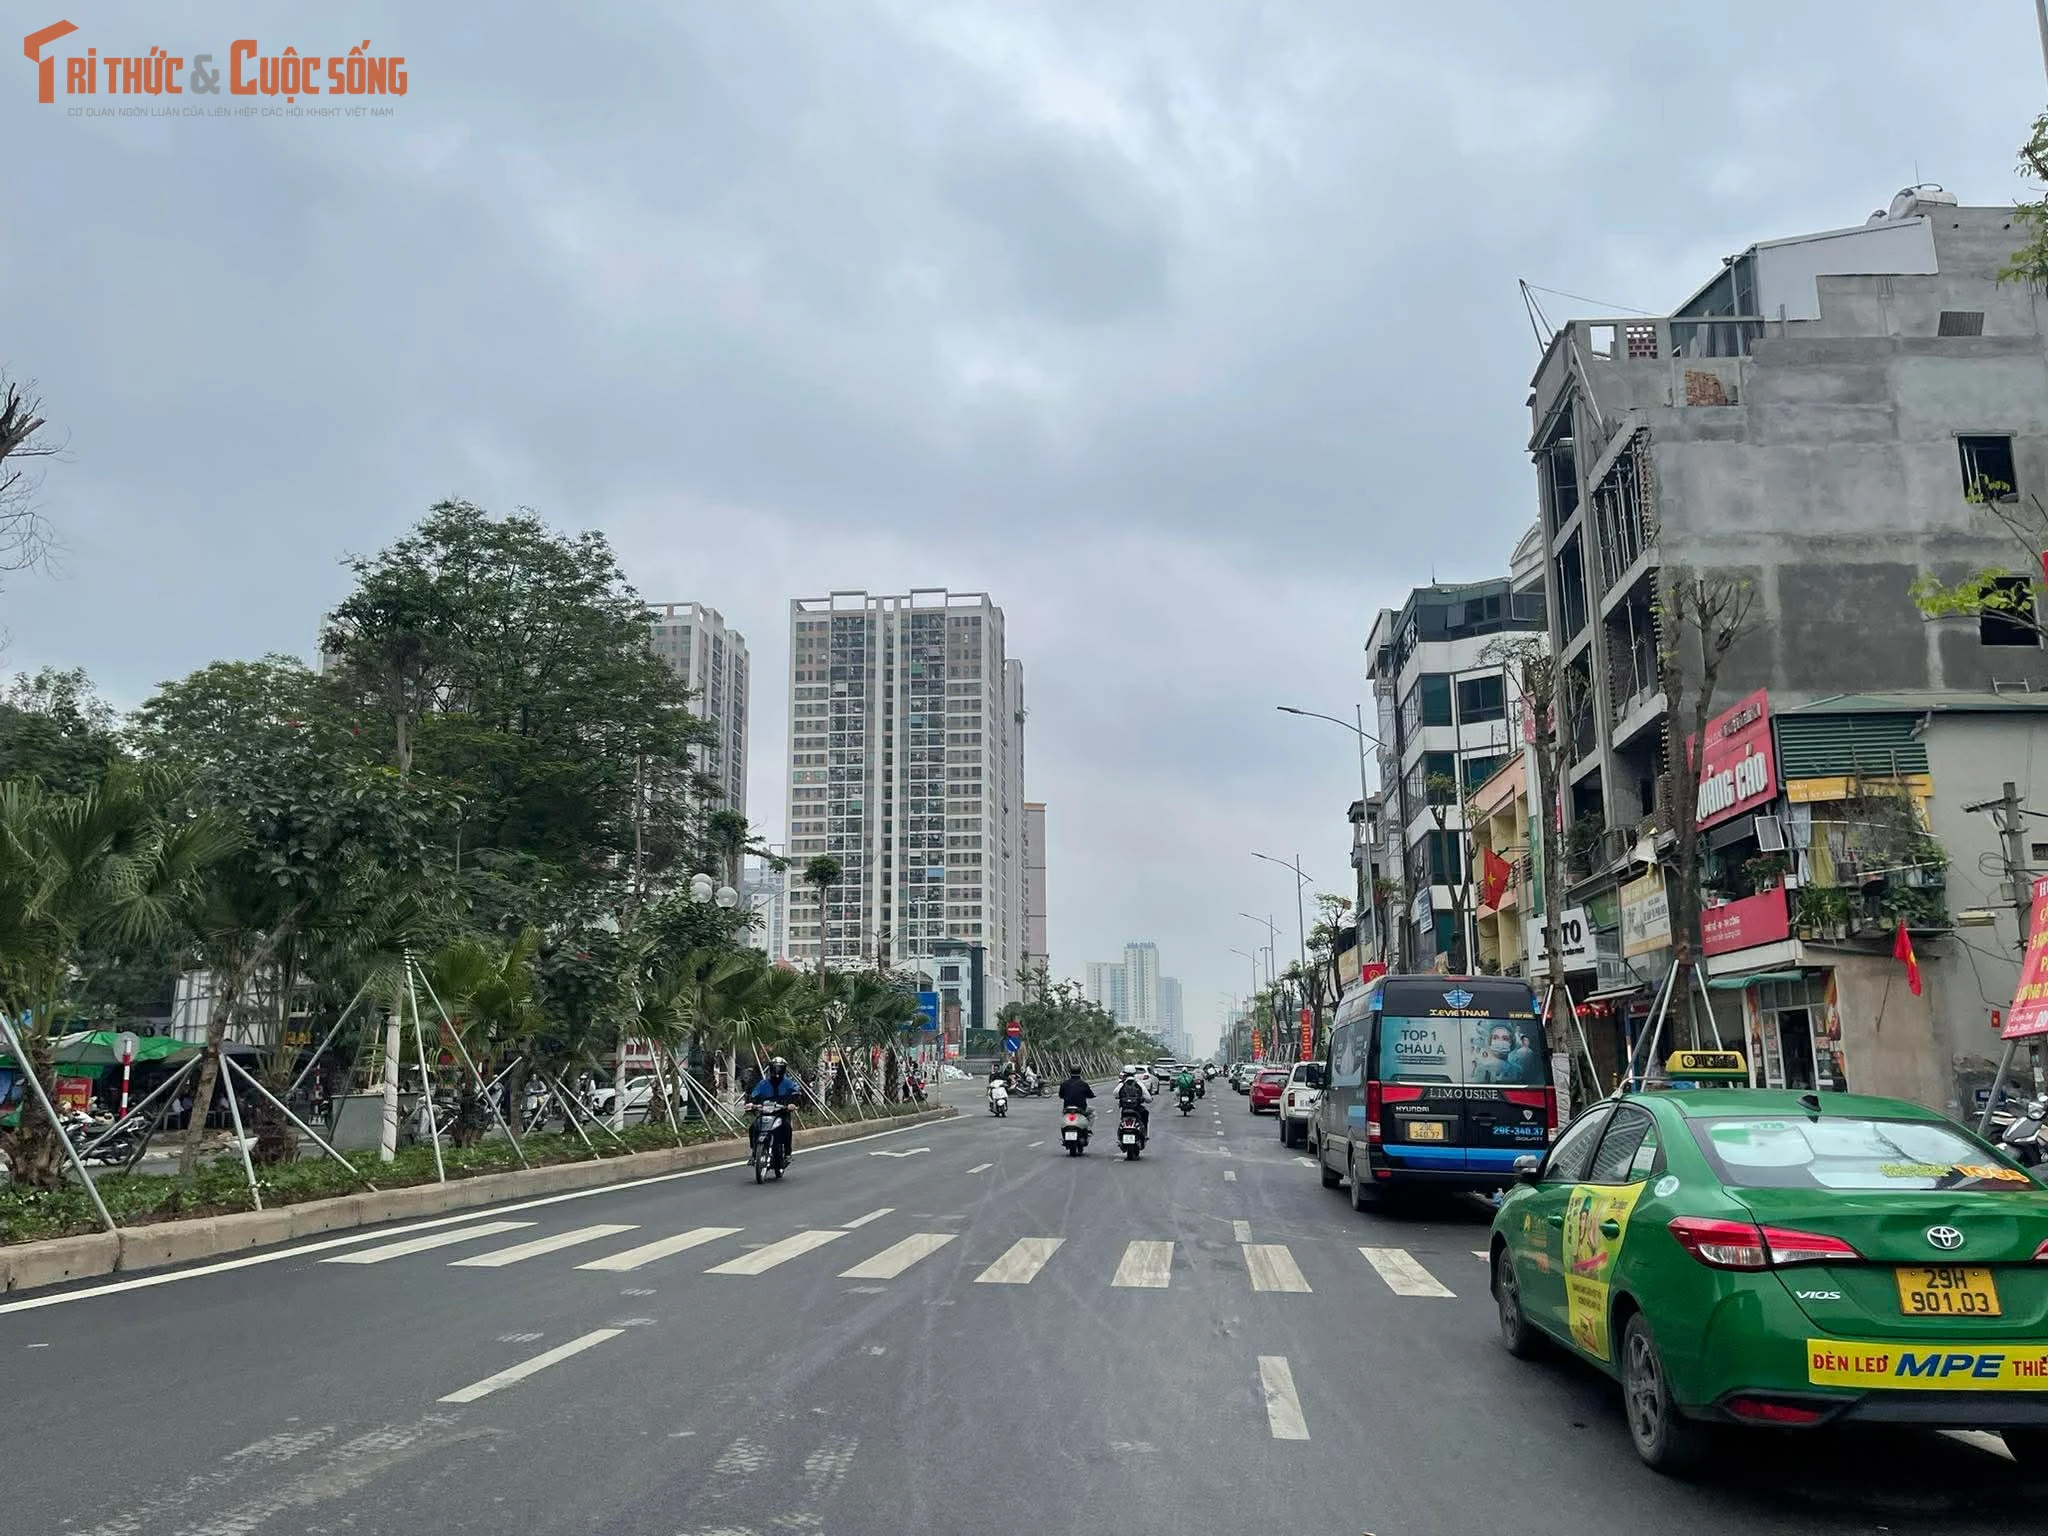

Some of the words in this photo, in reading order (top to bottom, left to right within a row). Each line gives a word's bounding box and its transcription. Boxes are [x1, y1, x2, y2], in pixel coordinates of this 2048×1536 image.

[1696, 763, 1735, 824] UẢNG
[1735, 742, 1768, 801] CÁO
[1401, 1030, 1428, 1041] TOP
[1431, 1031, 1437, 1041] 1
[1428, 1088, 1498, 1100] LIMOUSINE
[1923, 1269, 1968, 1290] 29H
[1795, 1290, 1841, 1300] VIOS
[1910, 1291, 1990, 1313] 901.03
[1813, 1350, 1849, 1372] ĐÈN
[1855, 1355, 1889, 1373] LED
[1894, 1353, 2006, 1379] MPE
